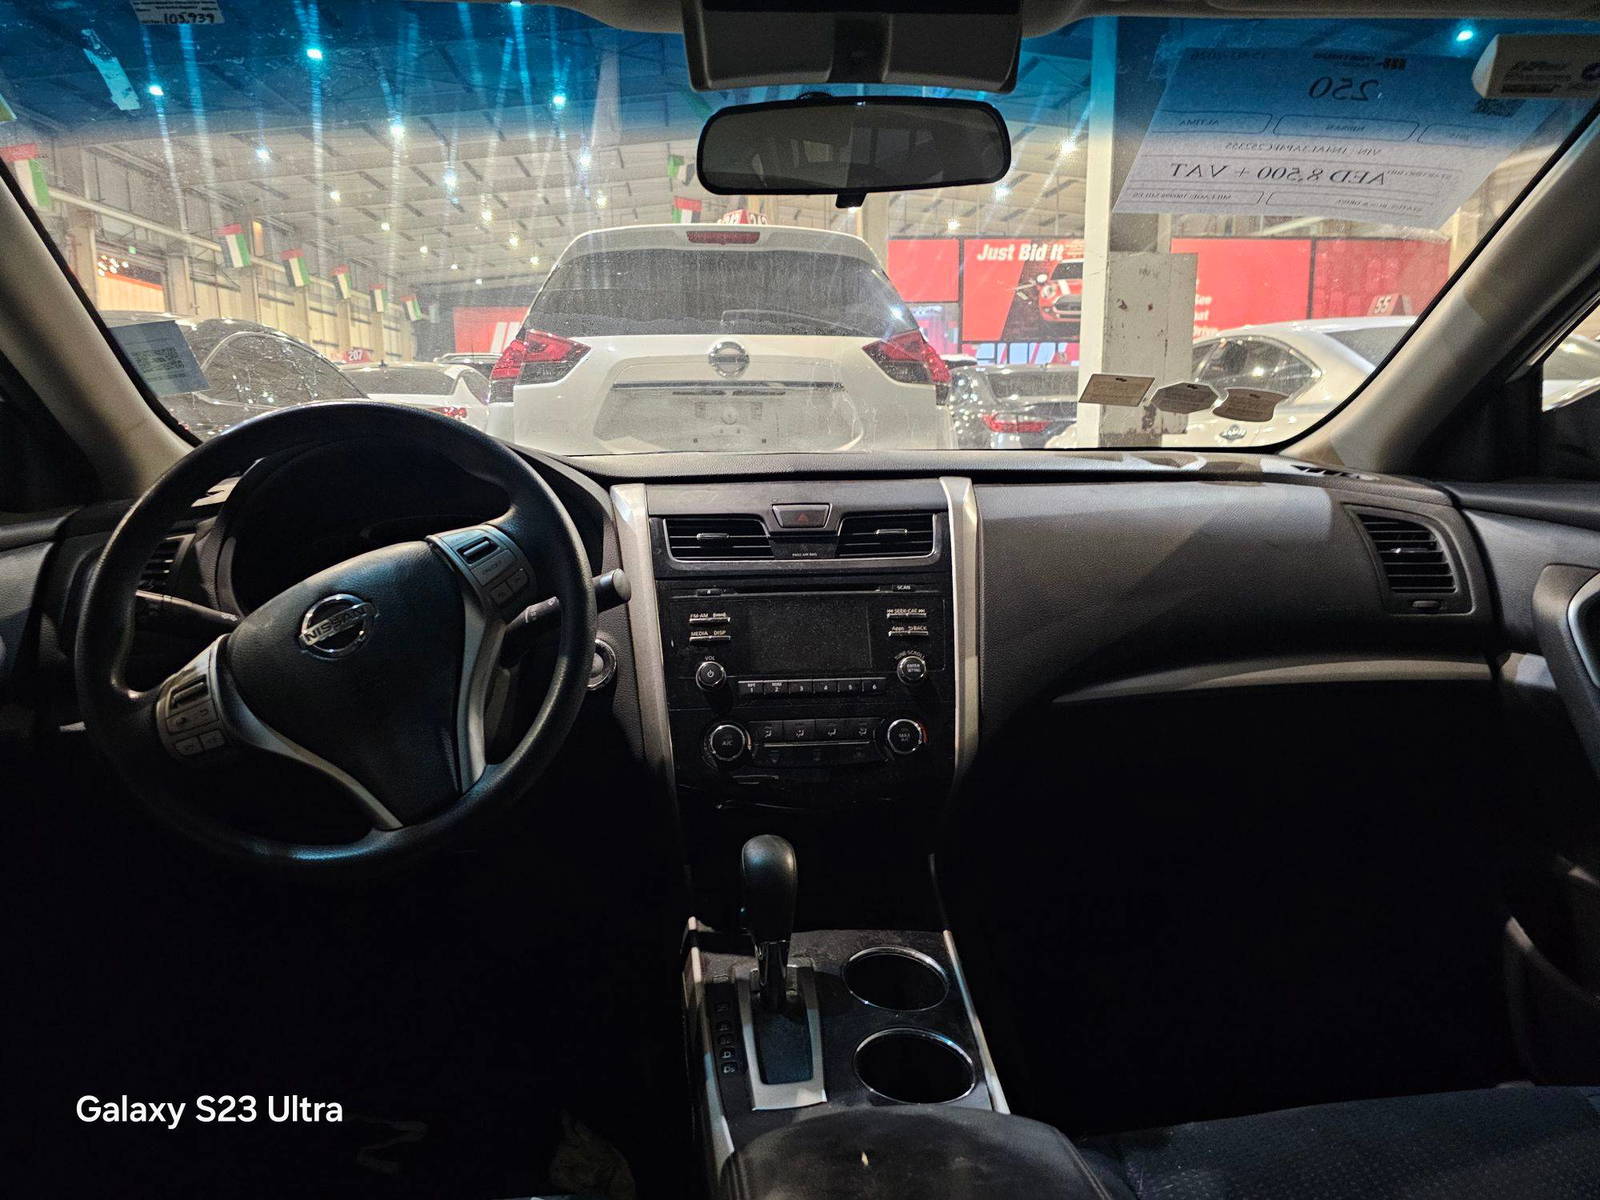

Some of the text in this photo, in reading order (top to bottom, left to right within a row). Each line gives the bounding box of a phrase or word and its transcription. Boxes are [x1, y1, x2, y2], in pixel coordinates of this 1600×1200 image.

[977, 243, 1015, 260] Just
[1018, 243, 1048, 261] Bid
[1050, 243, 1064, 261] It
[1374, 294, 1392, 314] 55
[348, 350, 363, 361] 207
[303, 605, 367, 643] NISSAN
